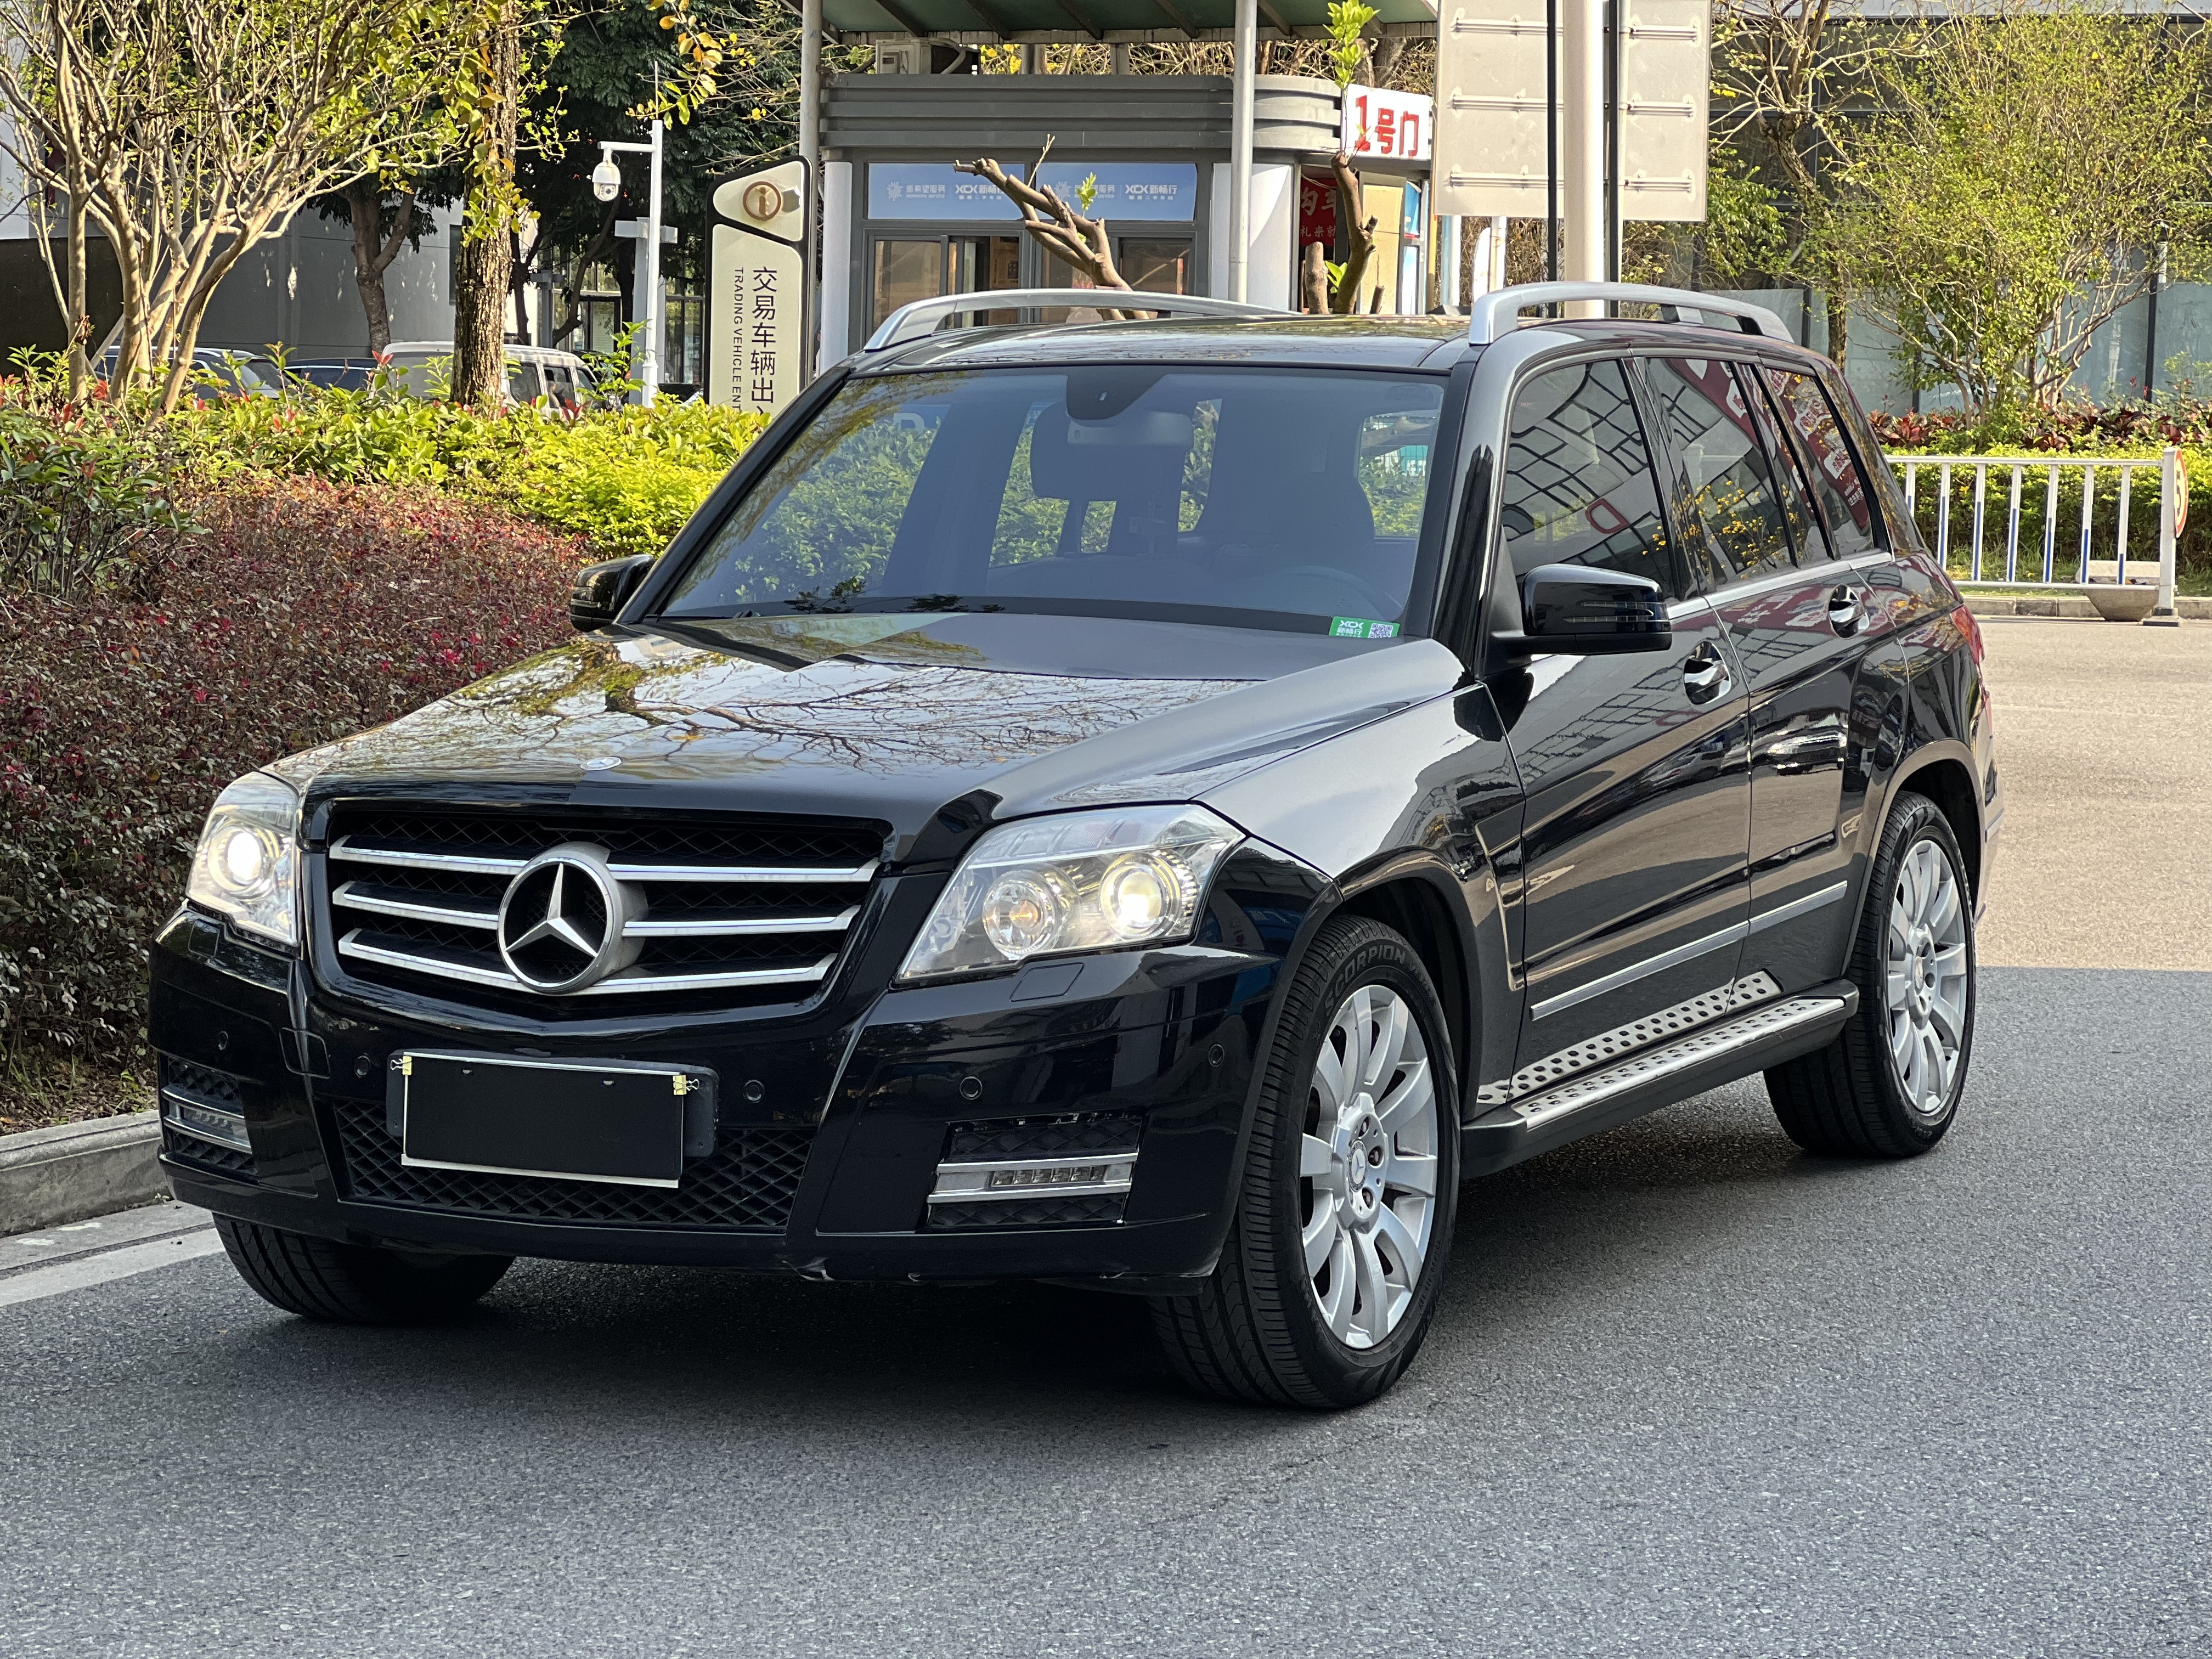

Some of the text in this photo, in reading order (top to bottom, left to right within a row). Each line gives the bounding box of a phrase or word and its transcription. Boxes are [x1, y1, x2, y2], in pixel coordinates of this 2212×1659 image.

[1355, 95, 1419, 157] 1号门
[1149, 184, 1177, 194] 新畅行
[733, 267, 743, 324] TRADING
[732, 328, 743, 382] VEHICLE
[1325, 945, 1406, 1017] SCORPION
